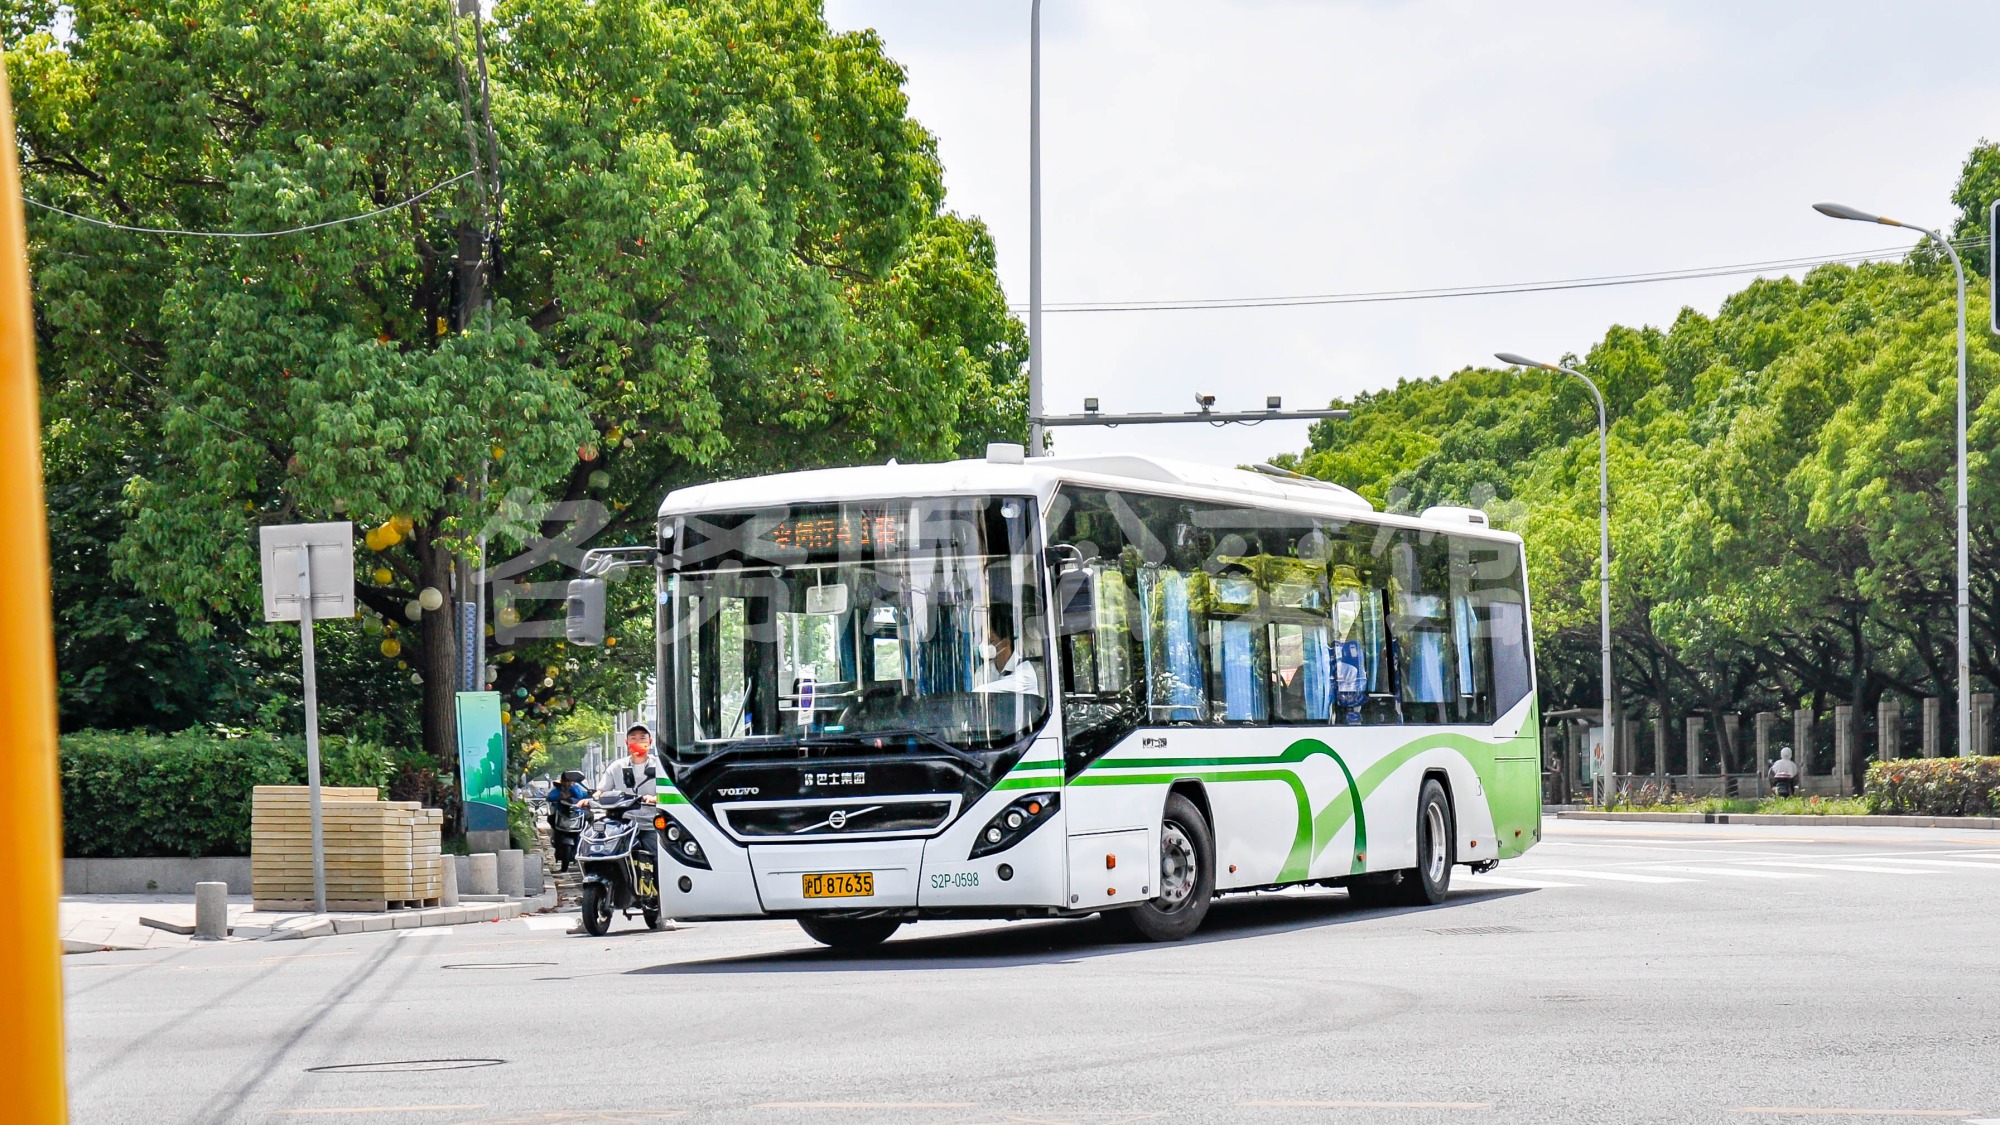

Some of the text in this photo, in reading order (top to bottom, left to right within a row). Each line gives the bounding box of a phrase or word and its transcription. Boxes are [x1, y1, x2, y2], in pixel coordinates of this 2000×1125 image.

[816, 772, 866, 786] 巴士集团
[717, 787, 760, 797] VOLVO
[930, 872, 979, 889] S2P-0598
